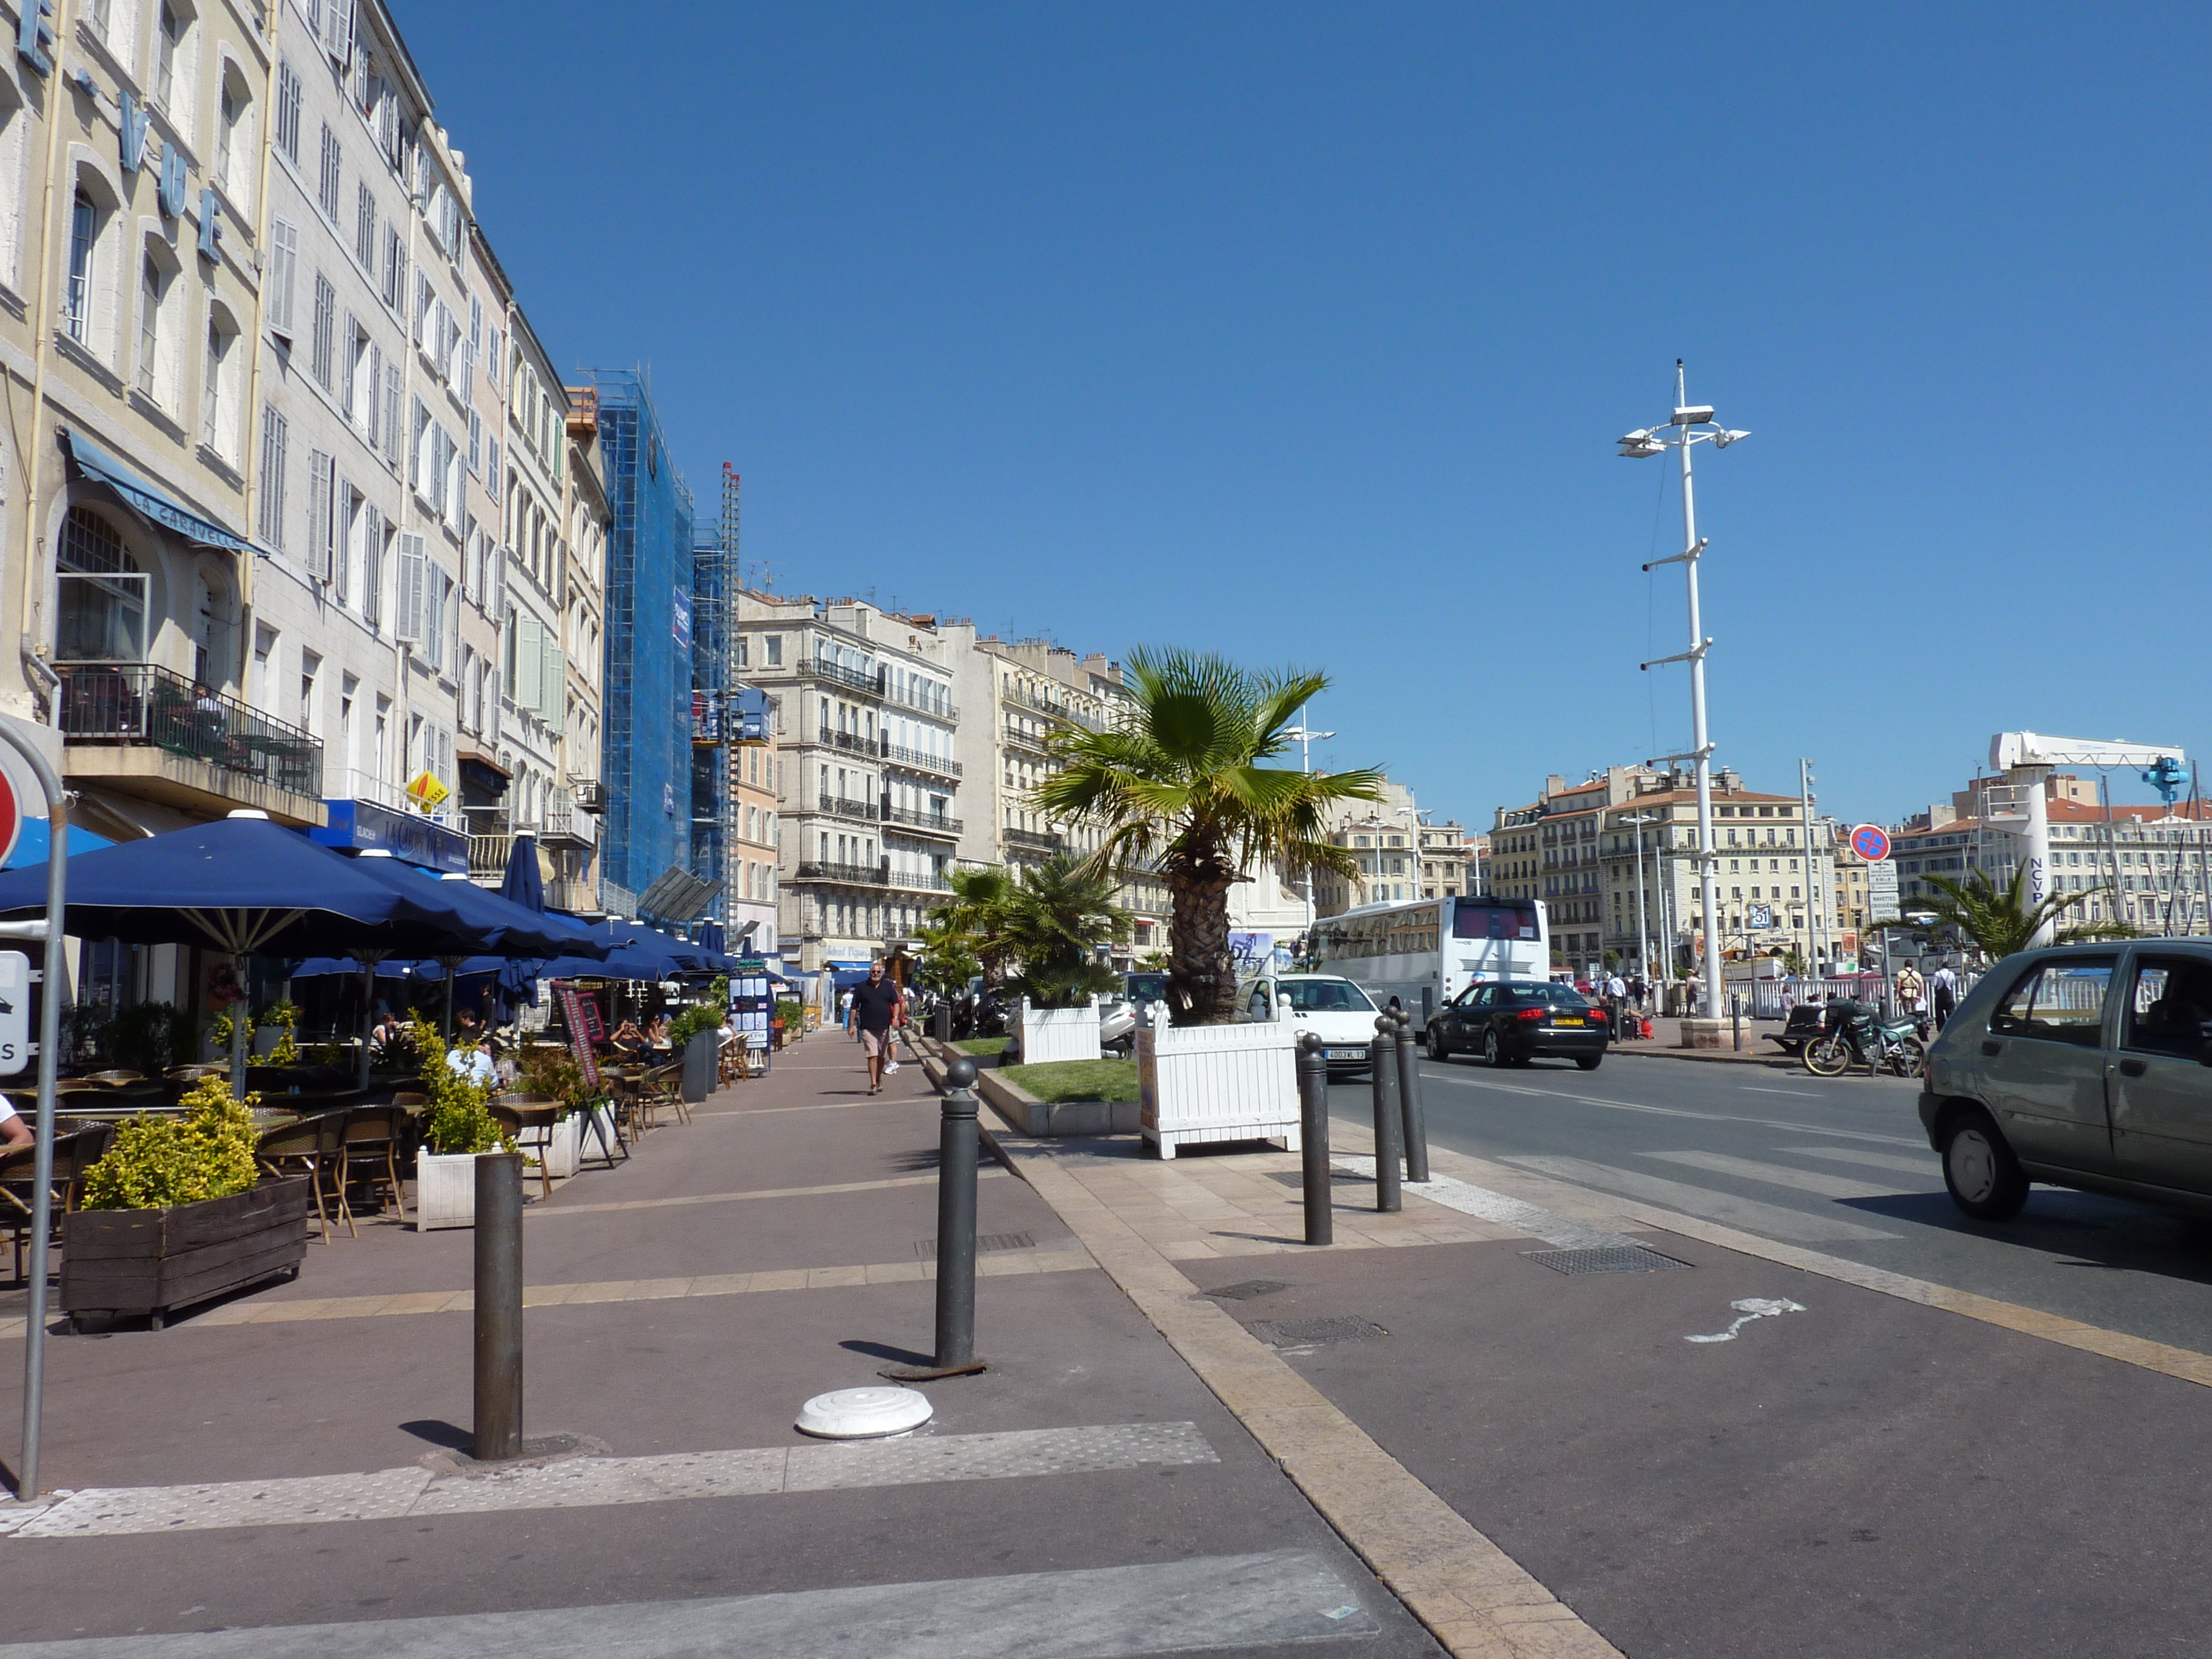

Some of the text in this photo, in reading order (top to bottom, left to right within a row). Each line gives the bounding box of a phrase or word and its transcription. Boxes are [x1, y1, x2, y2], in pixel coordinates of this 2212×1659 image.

[132, 492, 237, 547] LA CARAVELLE
[420, 788, 444, 811] PRESSE
[357, 824, 377, 842] GLACIER
[2030, 857, 2043, 903] NCVP
[1755, 911, 1767, 923] 51
